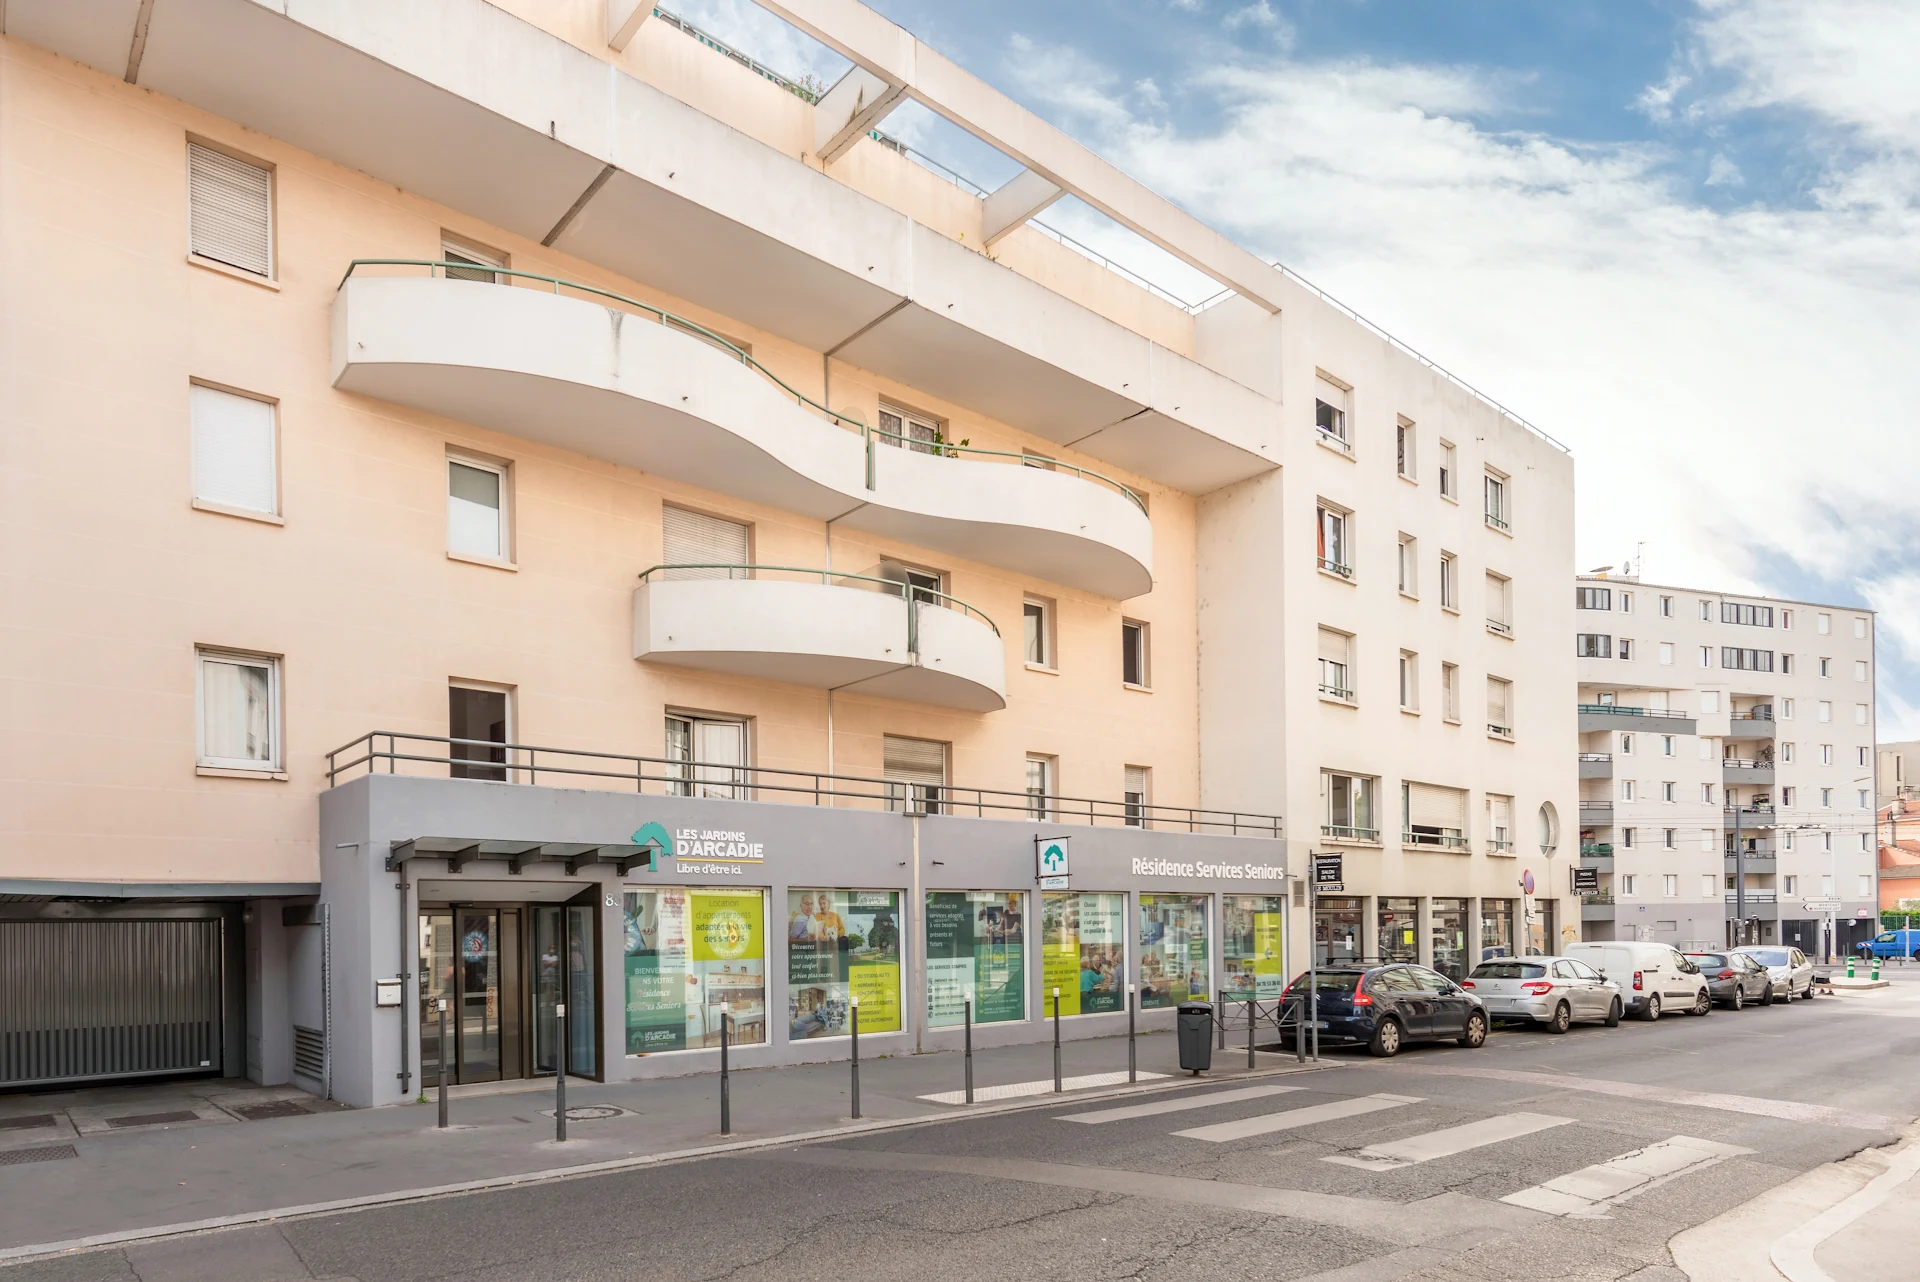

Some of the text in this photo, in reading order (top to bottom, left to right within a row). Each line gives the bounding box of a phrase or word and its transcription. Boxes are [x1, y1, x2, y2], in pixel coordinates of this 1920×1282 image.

[676, 829, 745, 842] LES JARDINS
[676, 840, 763, 858] D'ARCADIE
[676, 863, 700, 874] Libre
[702, 864, 729, 874] d'être
[1132, 857, 1284, 880] Résidence Services Seniors
[695, 911, 752, 920] d'appartements
[696, 923, 724, 931] adaptés
[635, 967, 673, 975] BIENVENUE
[656, 1001, 682, 1010] Seniors
